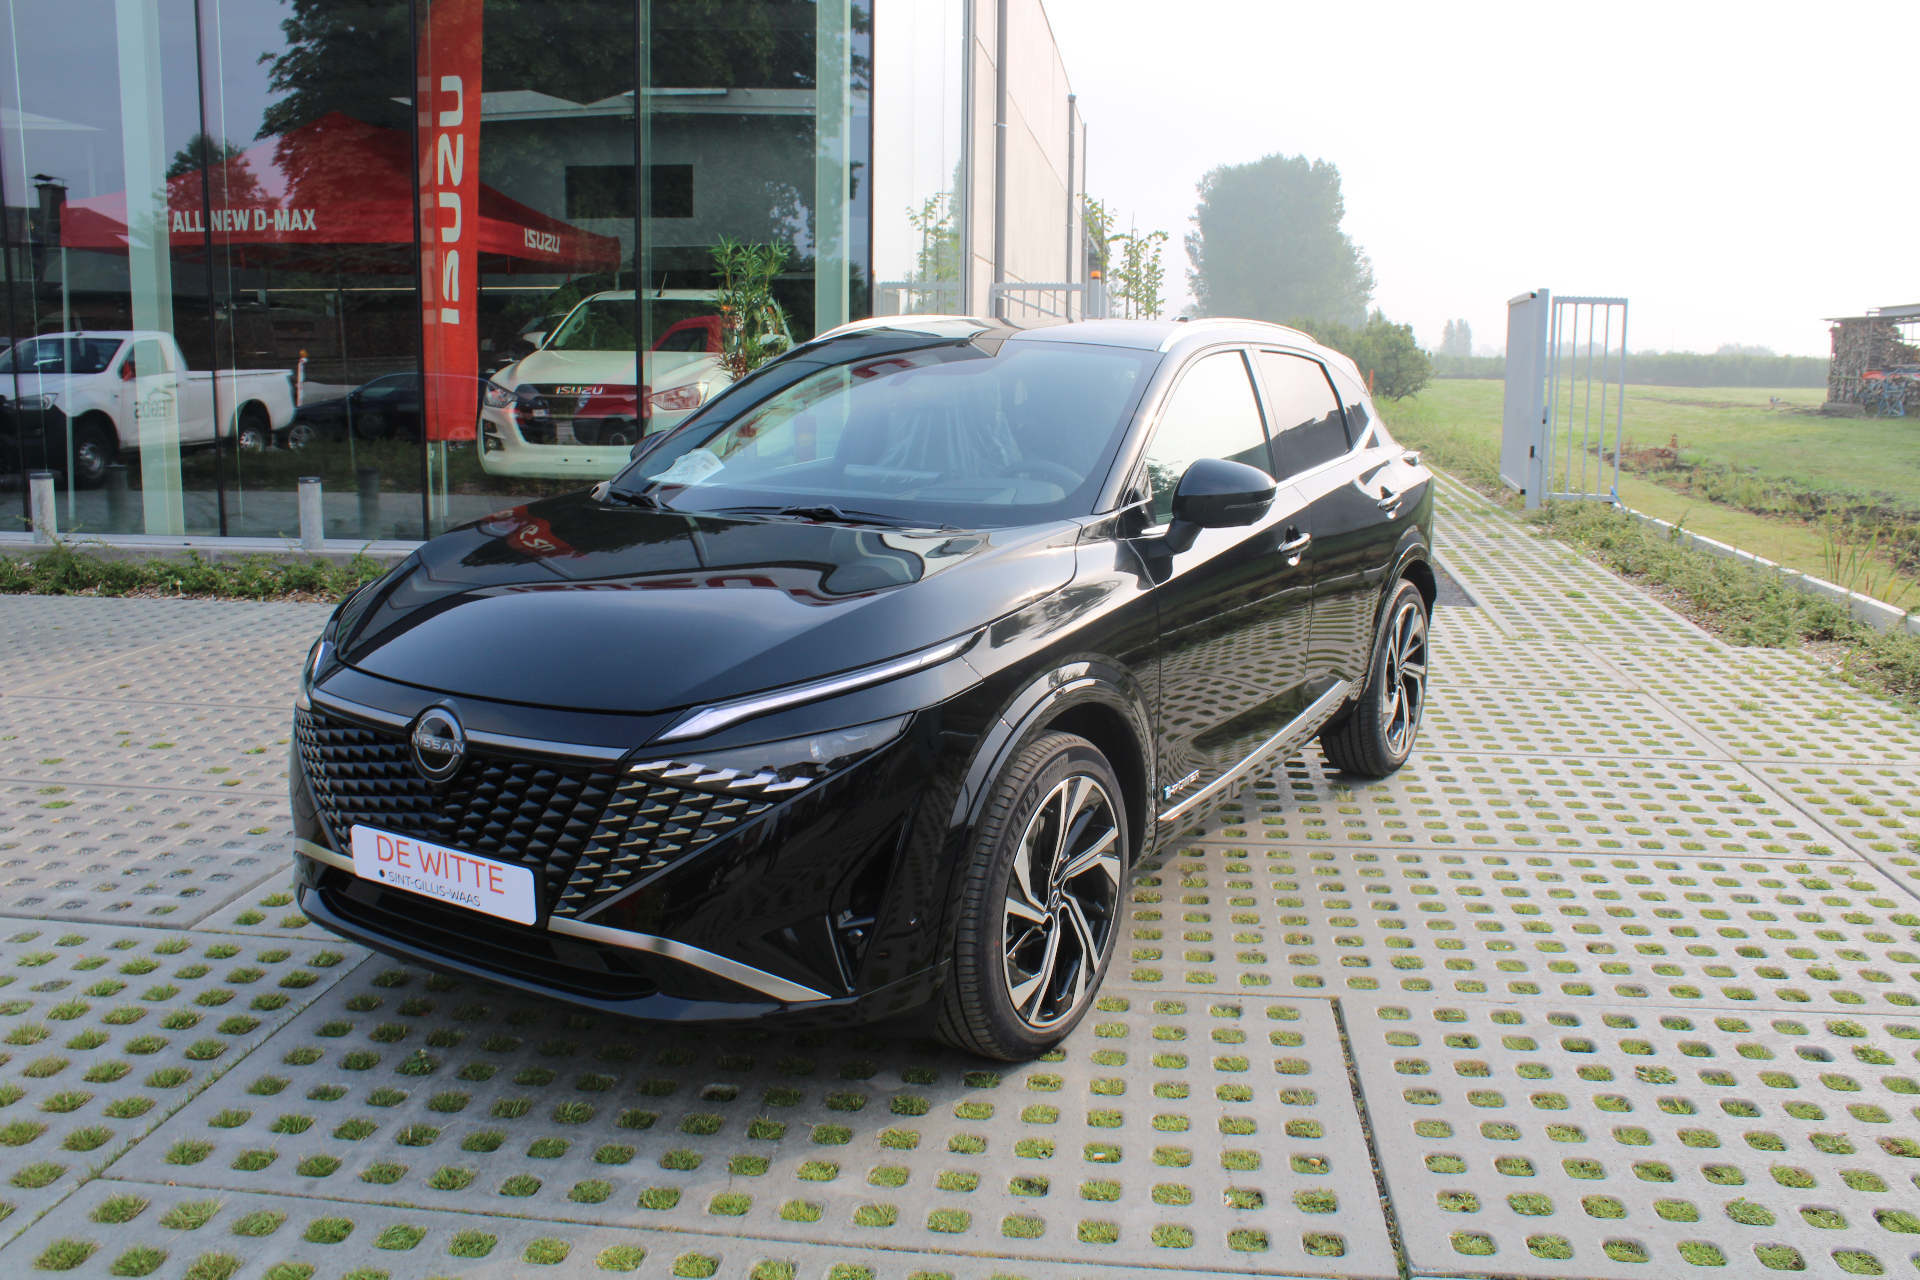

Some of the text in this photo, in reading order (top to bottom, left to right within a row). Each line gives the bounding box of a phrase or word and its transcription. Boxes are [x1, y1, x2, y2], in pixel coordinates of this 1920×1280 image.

[437, 75, 464, 325] ISUZU
[172, 208, 317, 233] ALL NEW D-MAX
[524, 228, 560, 254] ISUZU
[555, 386, 604, 395] ISUZU
[411, 731, 465, 754] NISSAN
[376, 834, 505, 895] DE WITTE
[388, 871, 481, 907] SINT-GILLIS-WAAS
